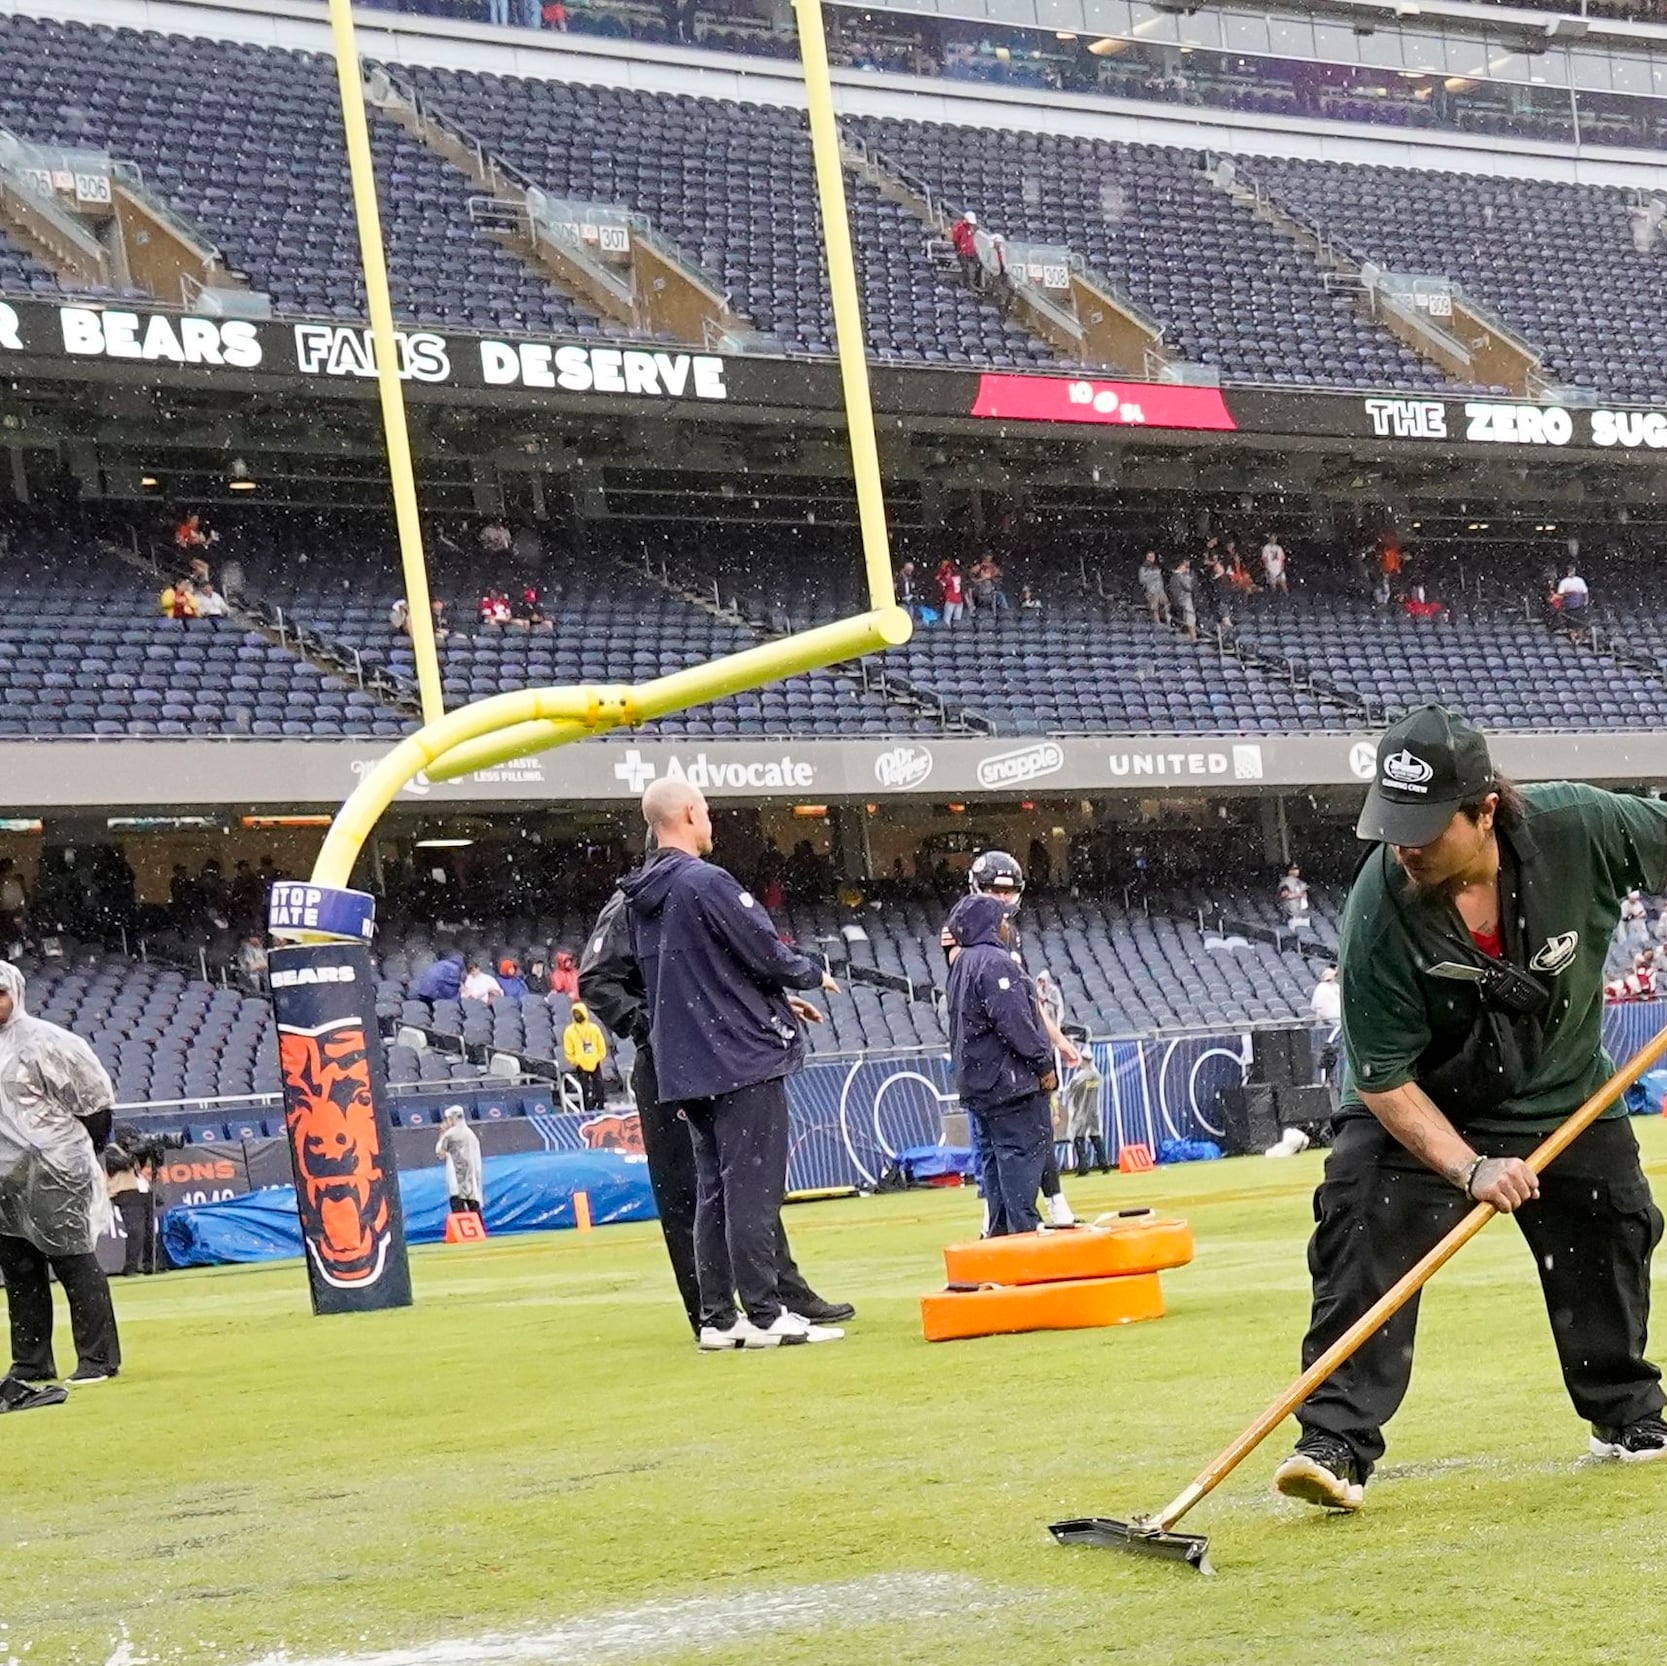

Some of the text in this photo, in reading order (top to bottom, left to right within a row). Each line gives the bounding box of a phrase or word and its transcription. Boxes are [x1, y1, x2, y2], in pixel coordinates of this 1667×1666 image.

[77, 176, 108, 199] 306
[602, 229, 625, 249] 307
[1046, 267, 1066, 286] 308
[1431, 297, 1449, 313] 309
[60, 306, 263, 367] BEARS
[480, 340, 728, 399] DESERVE
[1365, 399, 1448, 439] THE
[1465, 403, 1573, 446] ZERO
[664, 754, 814, 787] Advocate
[983, 746, 1060, 784] snapple
[1109, 753, 1228, 775] UNITED
[270, 966, 355, 988] BEARS
[1127, 1149, 1149, 1168] 10
[457, 1217, 478, 1238] G
